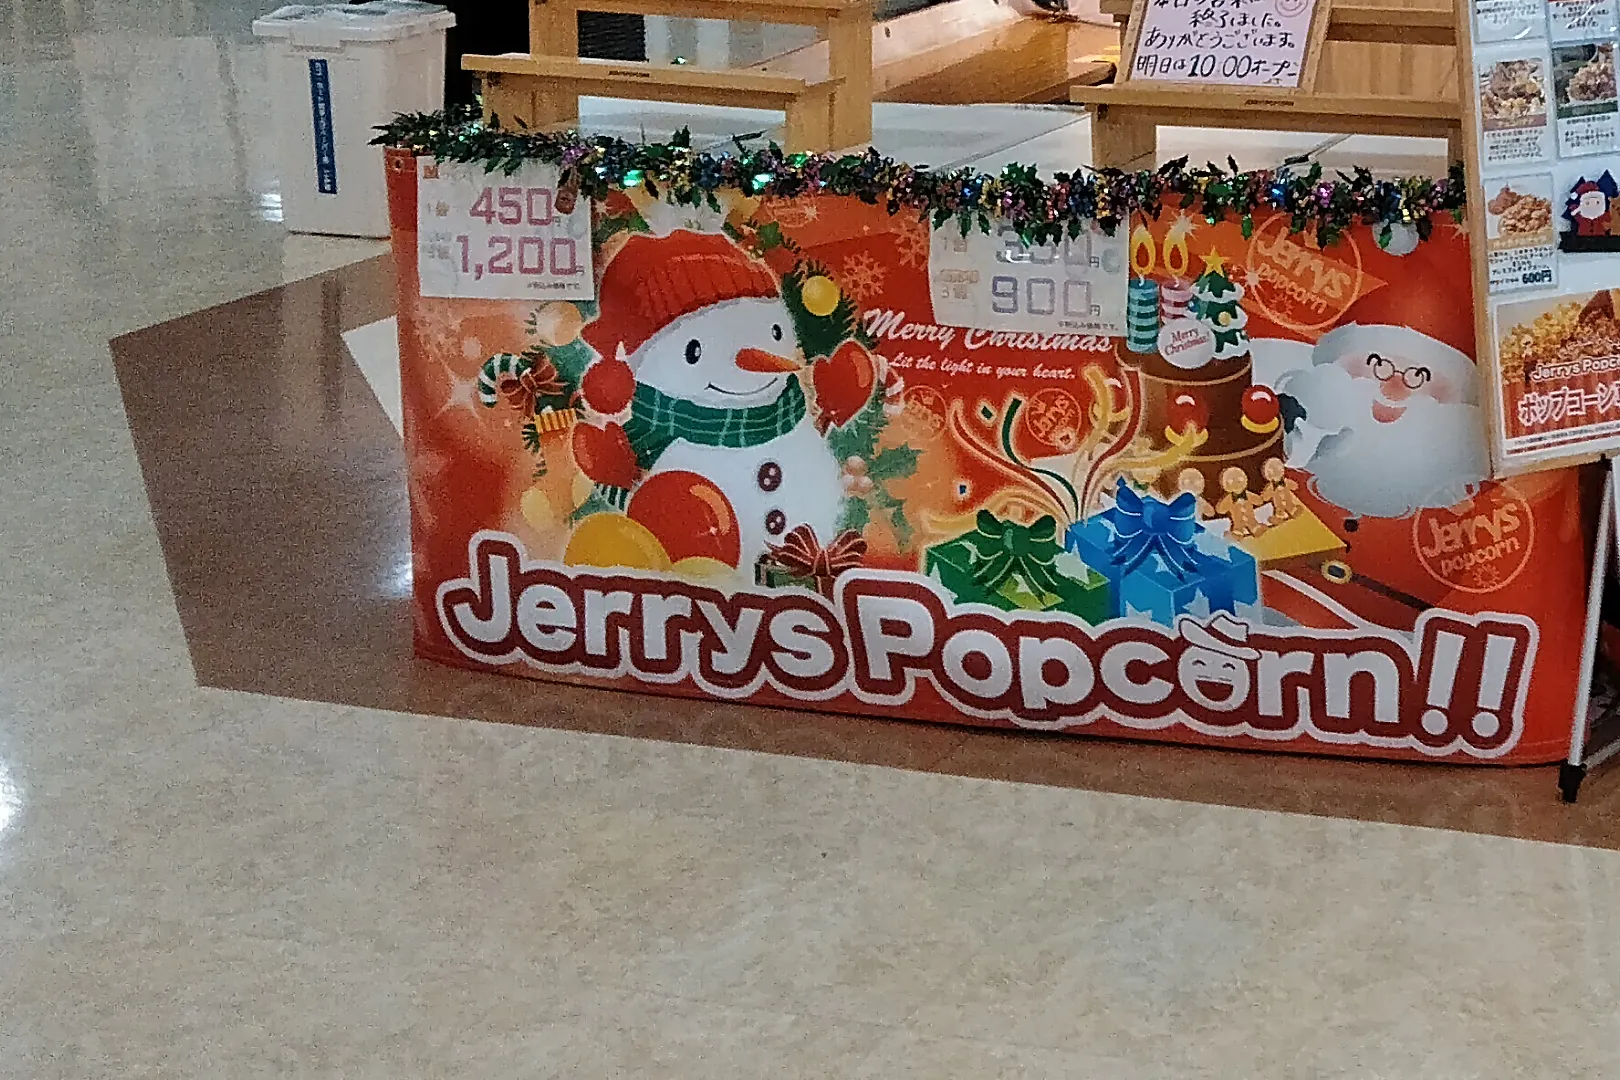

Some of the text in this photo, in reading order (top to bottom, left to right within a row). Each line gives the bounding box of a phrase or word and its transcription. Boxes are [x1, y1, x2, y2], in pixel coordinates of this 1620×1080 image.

[1522, 269, 1552, 284] 600円
[863, 307, 956, 350] Merry
[915, 356, 936, 370] the
[977, 363, 992, 375] in
[997, 367, 1027, 379] your
[1530, 362, 1583, 382] Jerrys
[440, 534, 1530, 754] Jerrys Popcorn!!
